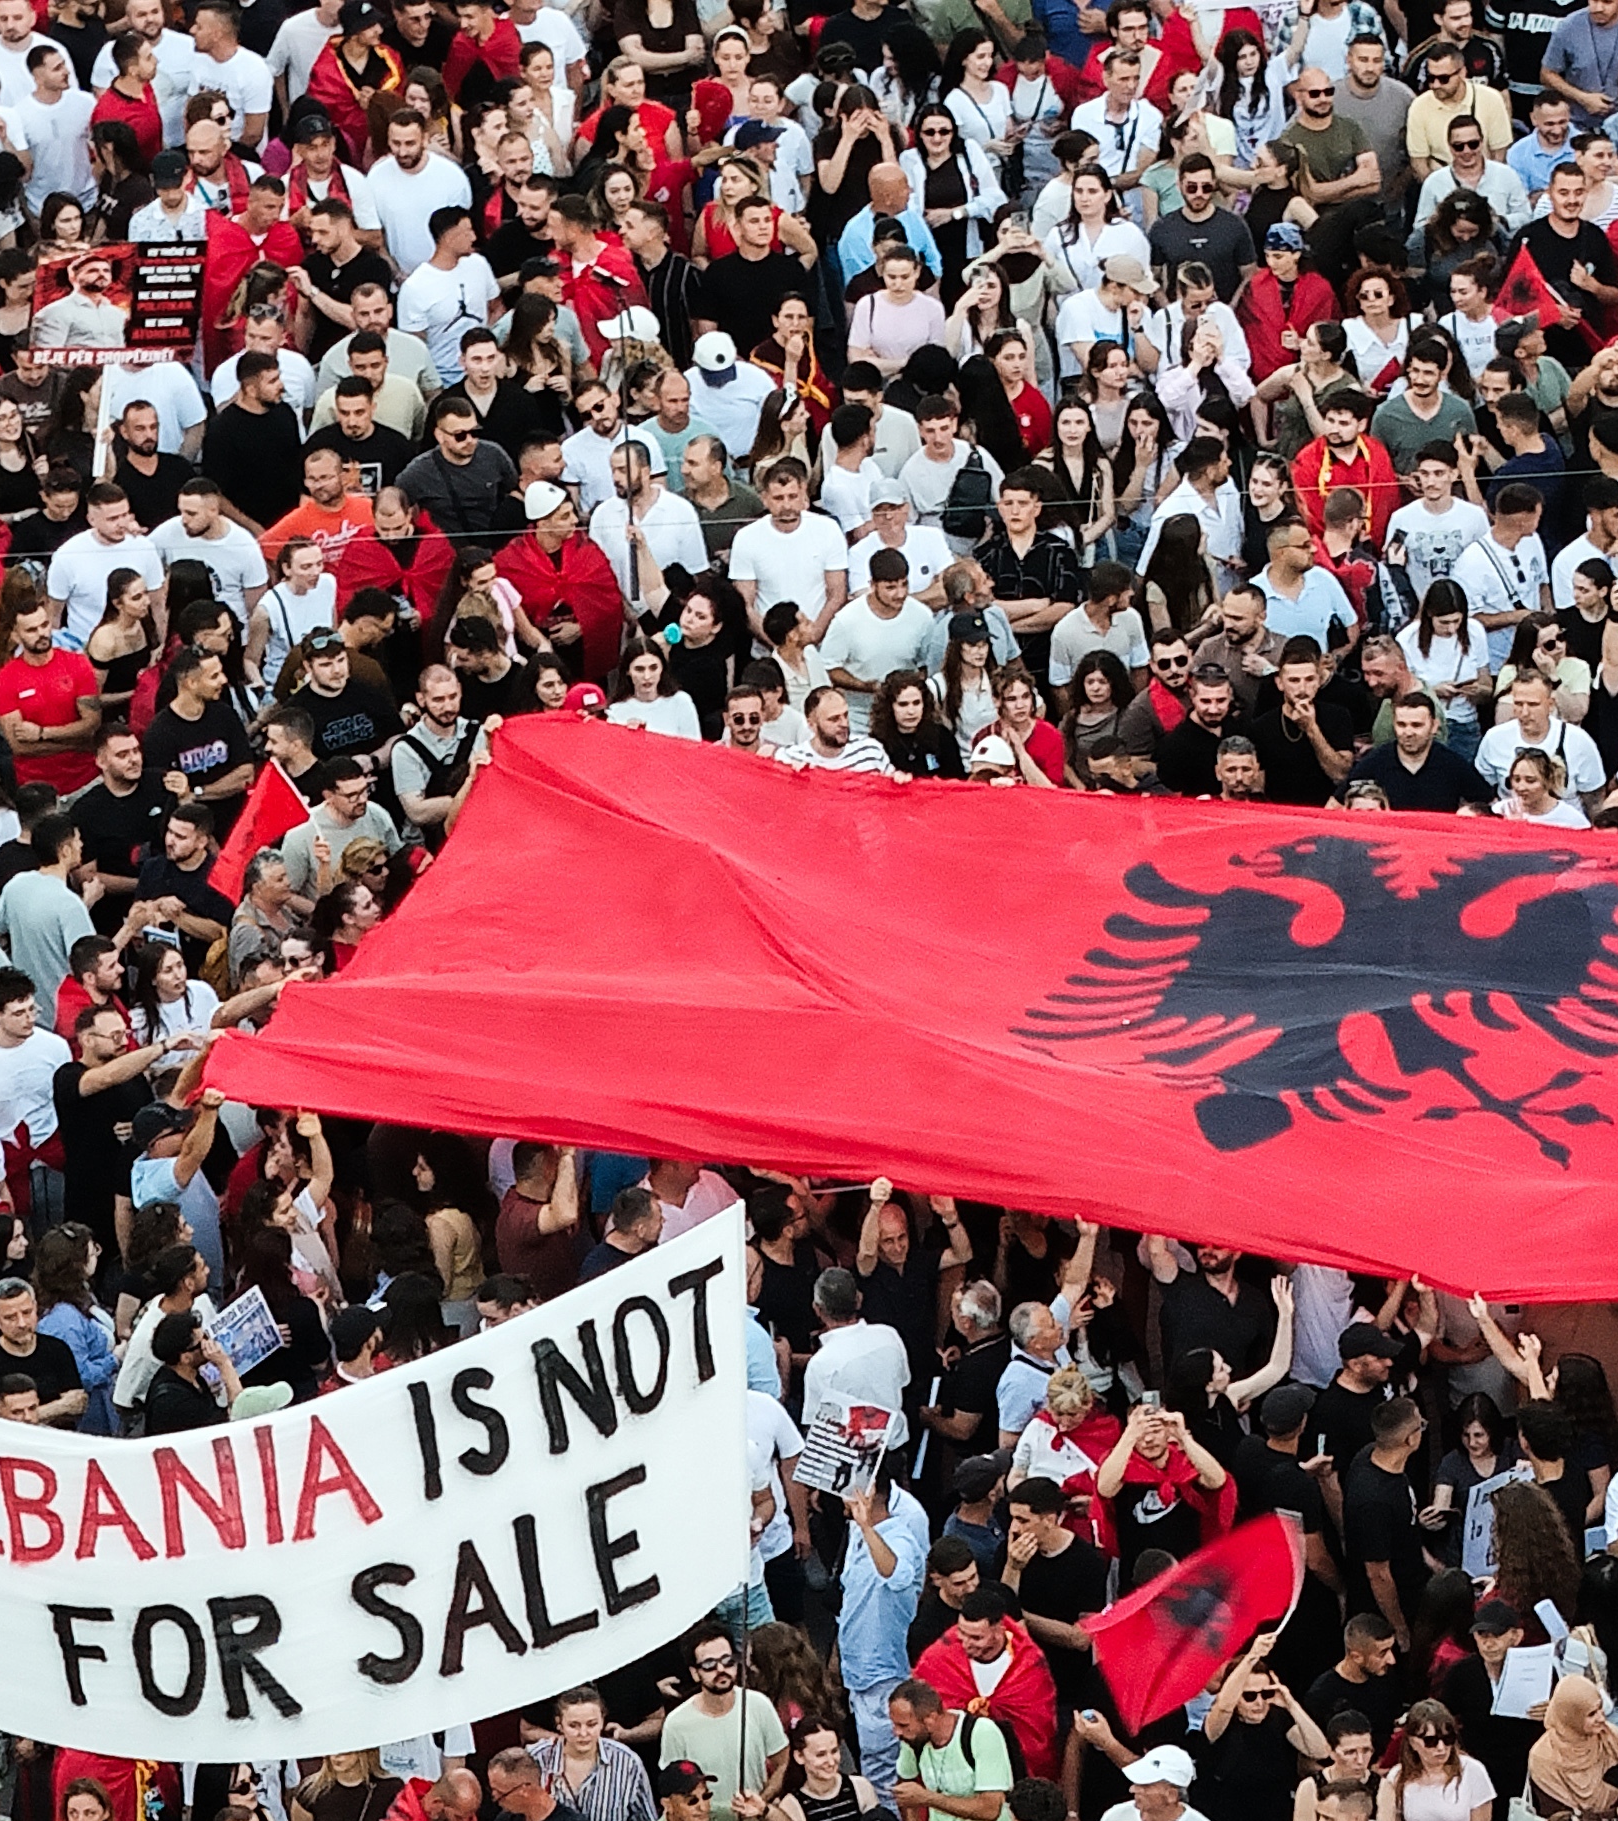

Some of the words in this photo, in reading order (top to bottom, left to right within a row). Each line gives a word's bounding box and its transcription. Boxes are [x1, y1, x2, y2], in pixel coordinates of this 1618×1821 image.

[406, 1366, 512, 1502] IS
[530, 1254, 726, 1456] NOT
[46, 1593, 304, 1721] FOR
[350, 1463, 664, 1687] SALE
